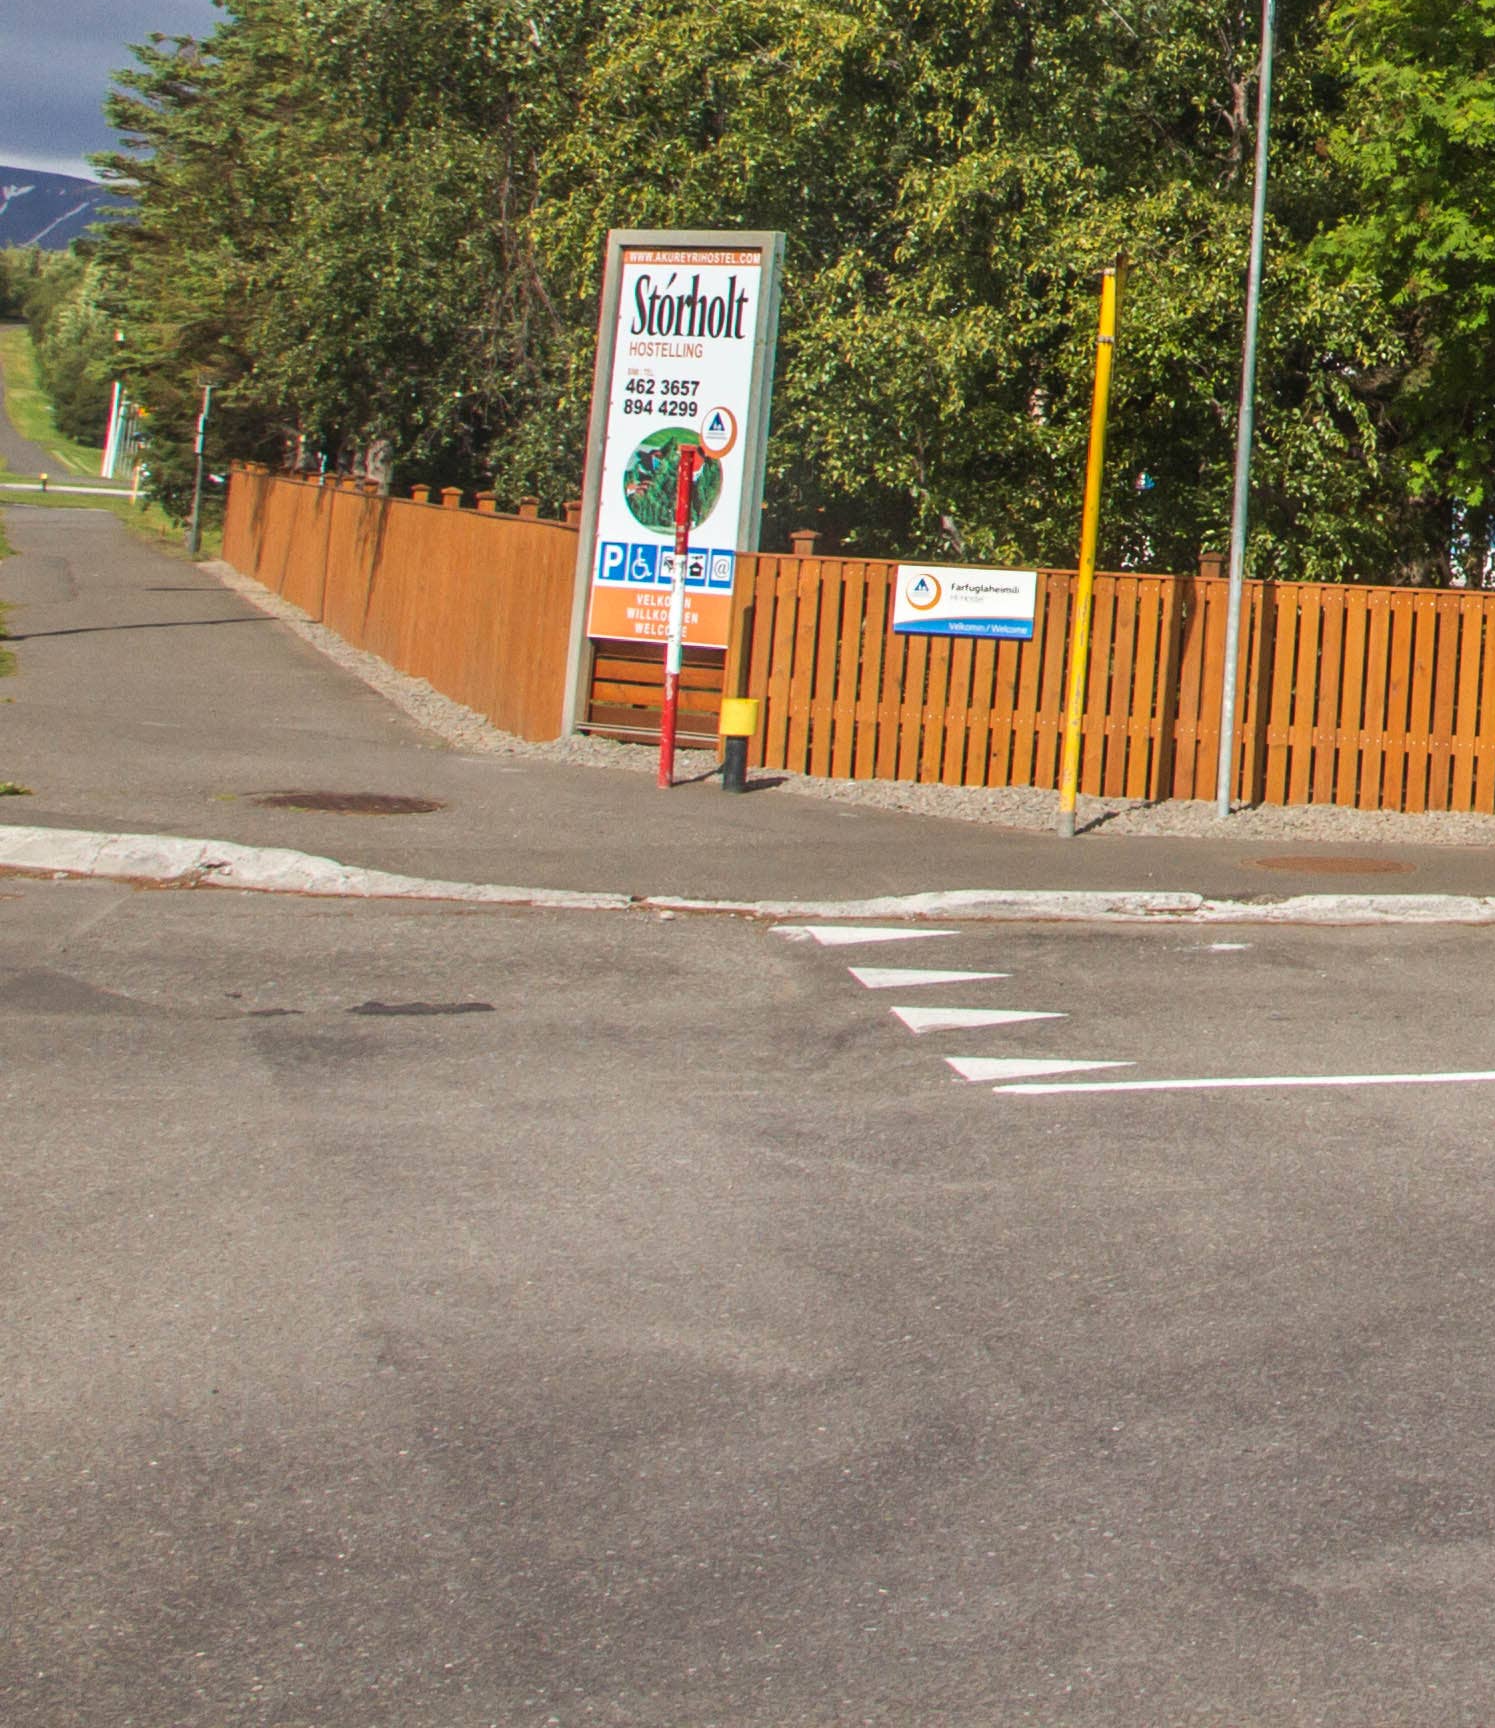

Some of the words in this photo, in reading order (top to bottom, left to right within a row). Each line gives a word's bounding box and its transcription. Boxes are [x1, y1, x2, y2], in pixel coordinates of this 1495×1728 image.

[629, 251, 760, 264] WWW.AKUREYRIHOSTEL.COM
[631, 272, 748, 339] Stórholt
[629, 341, 703, 358] HOSTELLING
[625, 378, 655, 395] 462
[660, 379, 700, 396] 3657
[624, 399, 653, 415] 894
[658, 400, 698, 417] 4299
[636, 593, 692, 609] VELKON
[626, 607, 699, 624] WILLKOEN
[634, 622, 688, 638] WELCOE
